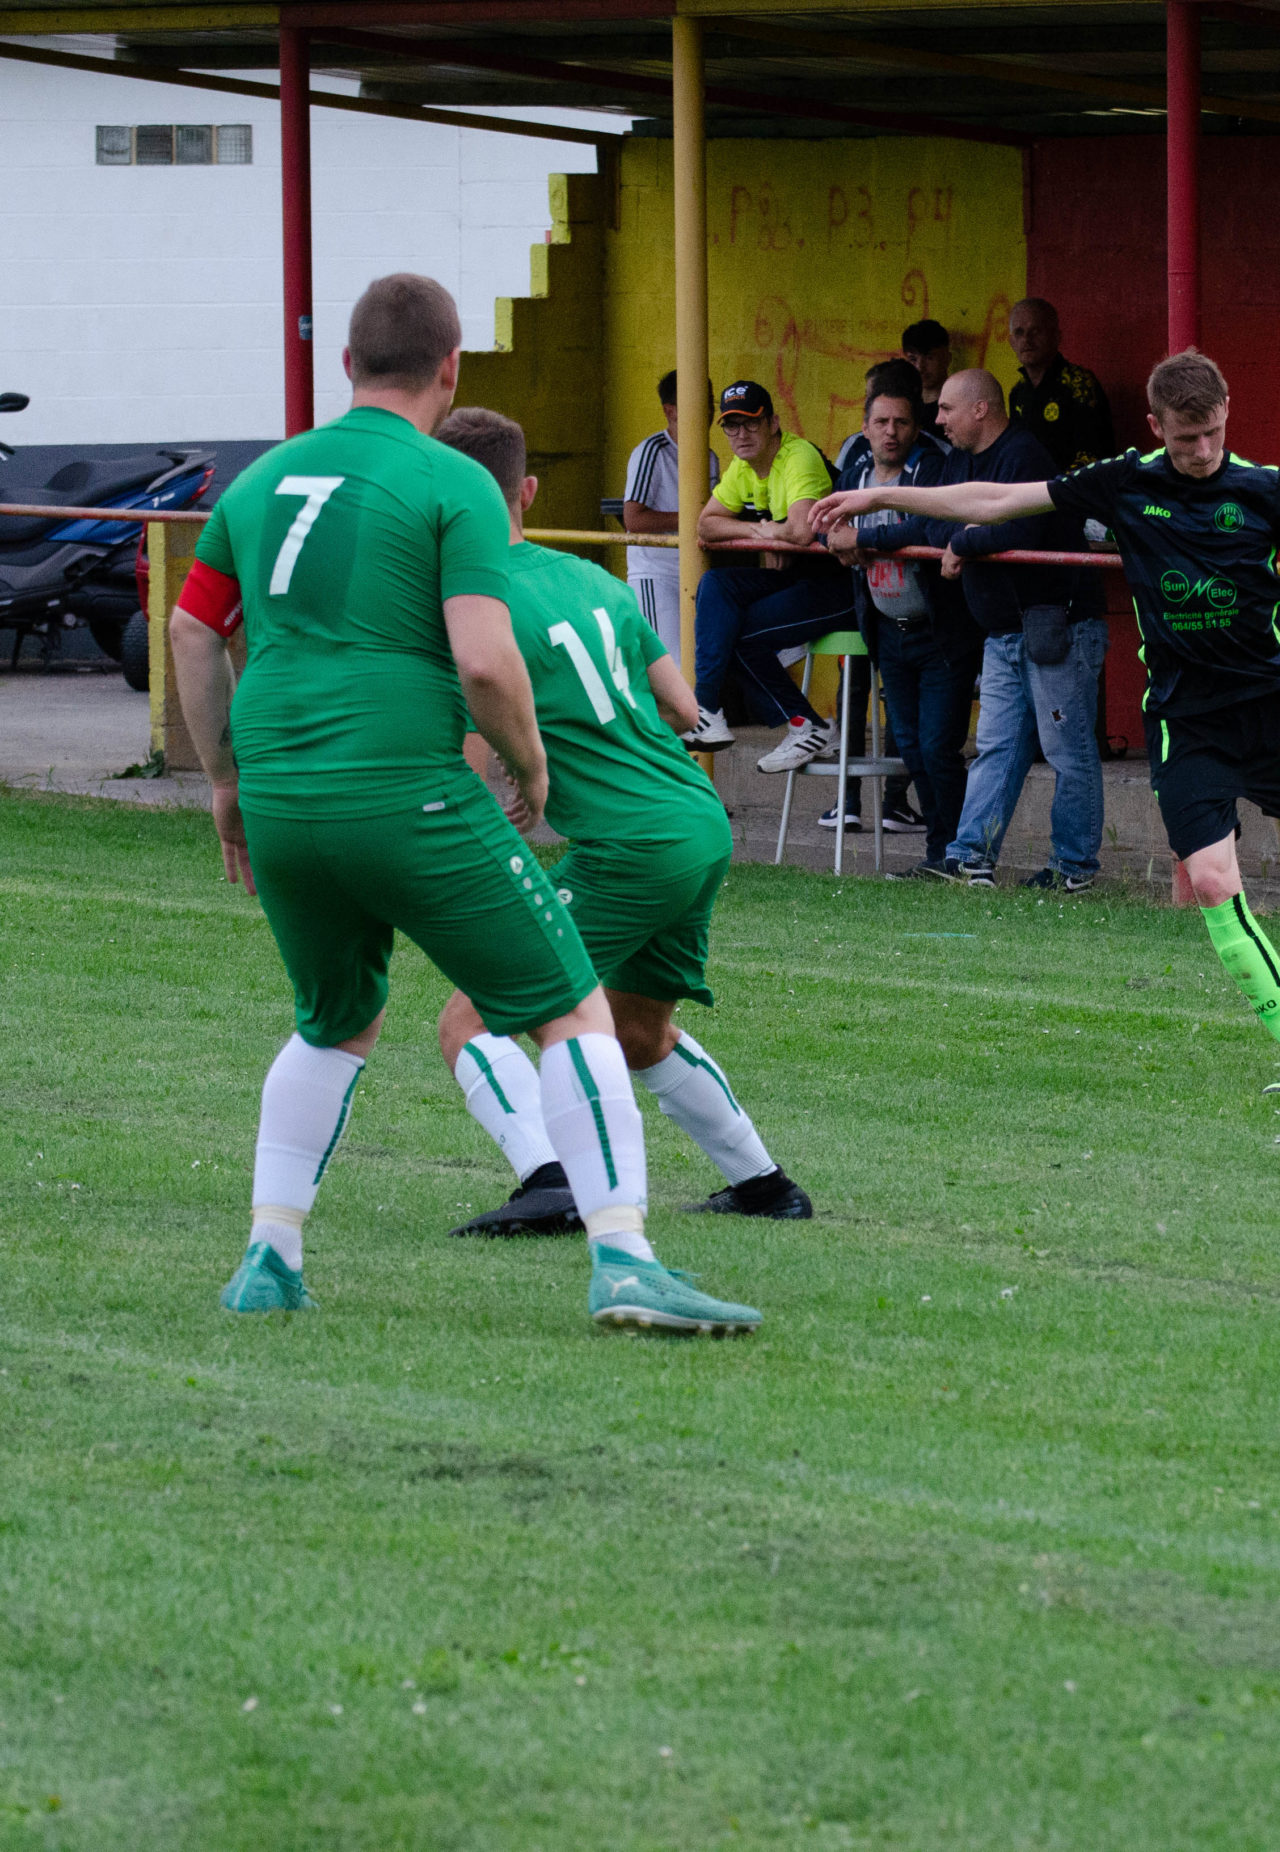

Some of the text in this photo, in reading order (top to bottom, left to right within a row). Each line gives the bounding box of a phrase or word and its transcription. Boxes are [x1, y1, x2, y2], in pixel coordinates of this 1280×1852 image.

[1143, 505, 1171, 519] JAKO
[269, 475, 345, 596] 7
[1163, 580, 1233, 599] Sun Elec
[1172, 621, 1203, 632] 064/55
[1219, 618, 1231, 629] 55
[547, 607, 636, 725] 14
